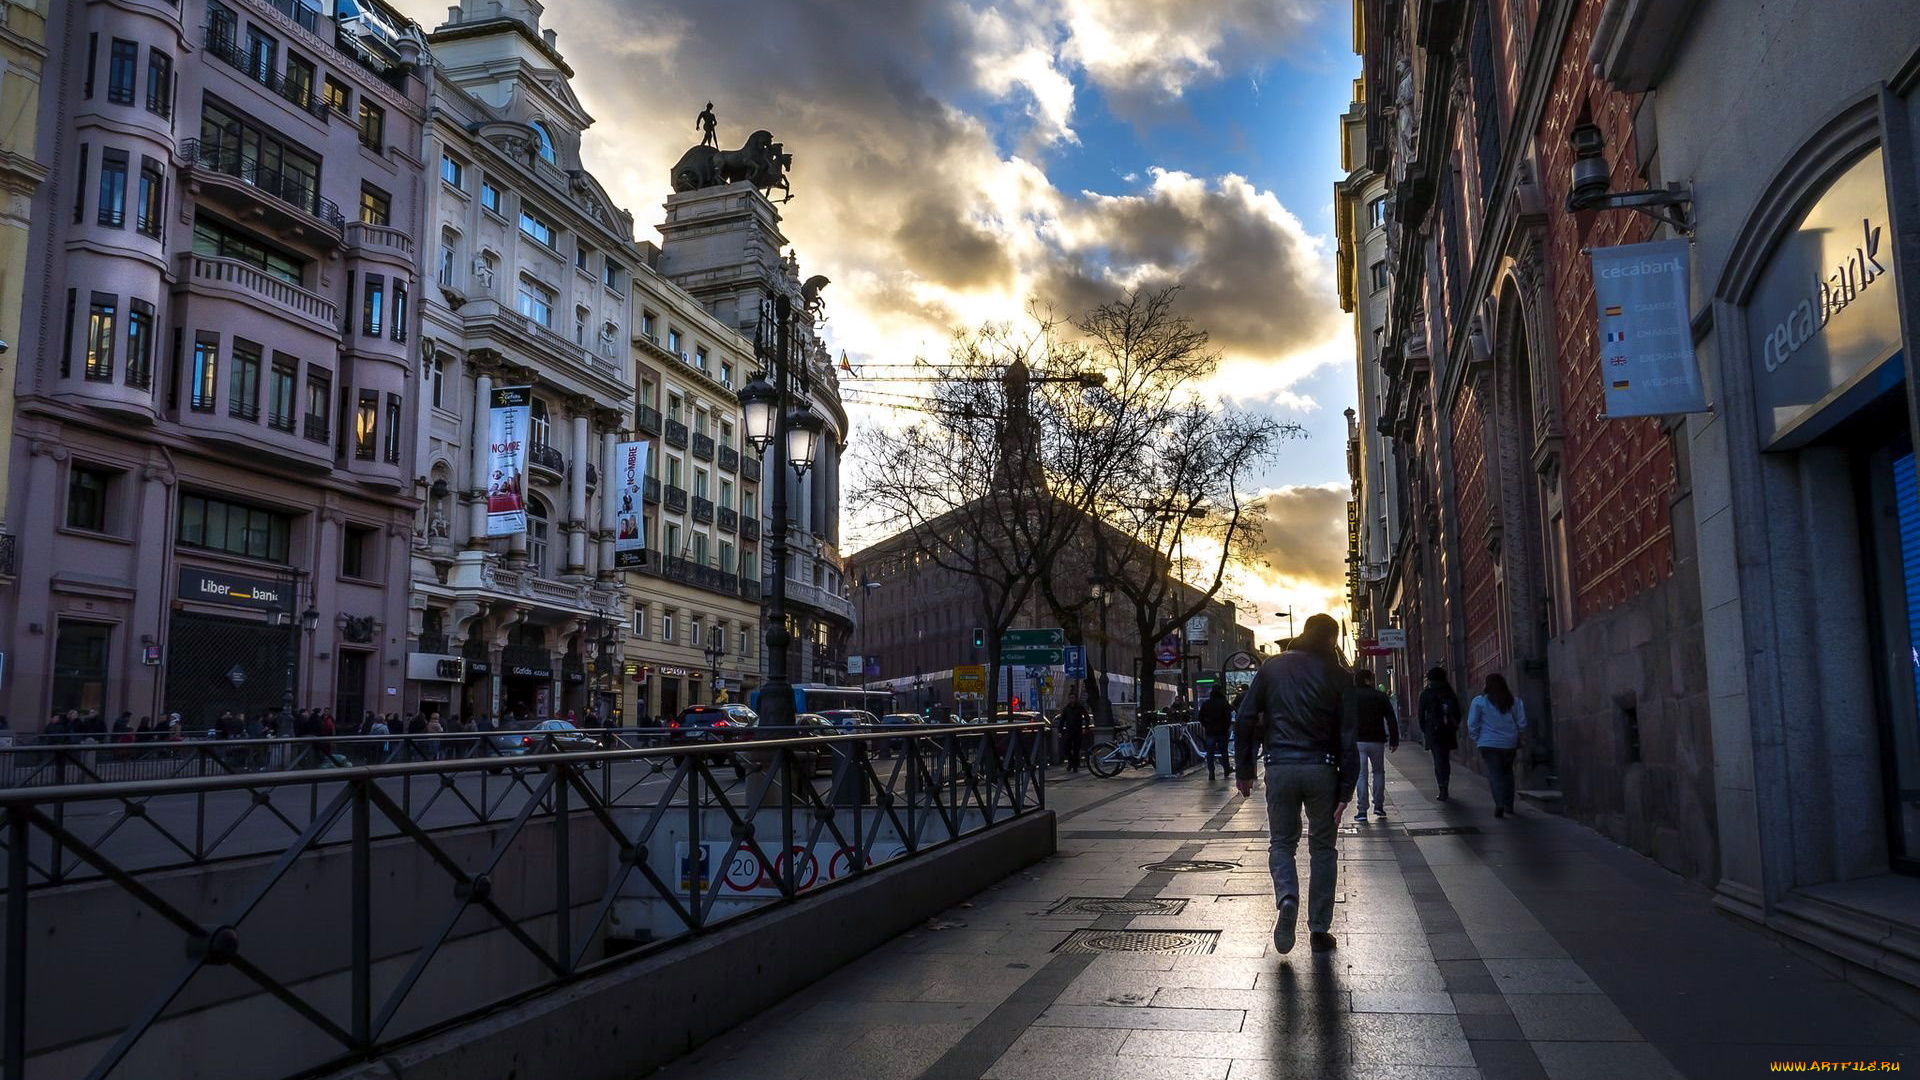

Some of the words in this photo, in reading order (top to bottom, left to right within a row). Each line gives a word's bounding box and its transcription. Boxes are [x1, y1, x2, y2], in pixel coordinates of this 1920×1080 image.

[1601, 258, 1684, 279] cecabank
[1764, 218, 1885, 374] cecabank
[627, 446, 637, 485] NOMBRE
[200, 579, 230, 595] Liber
[1070, 652, 1079, 663] P
[732, 858, 755, 877] 20
